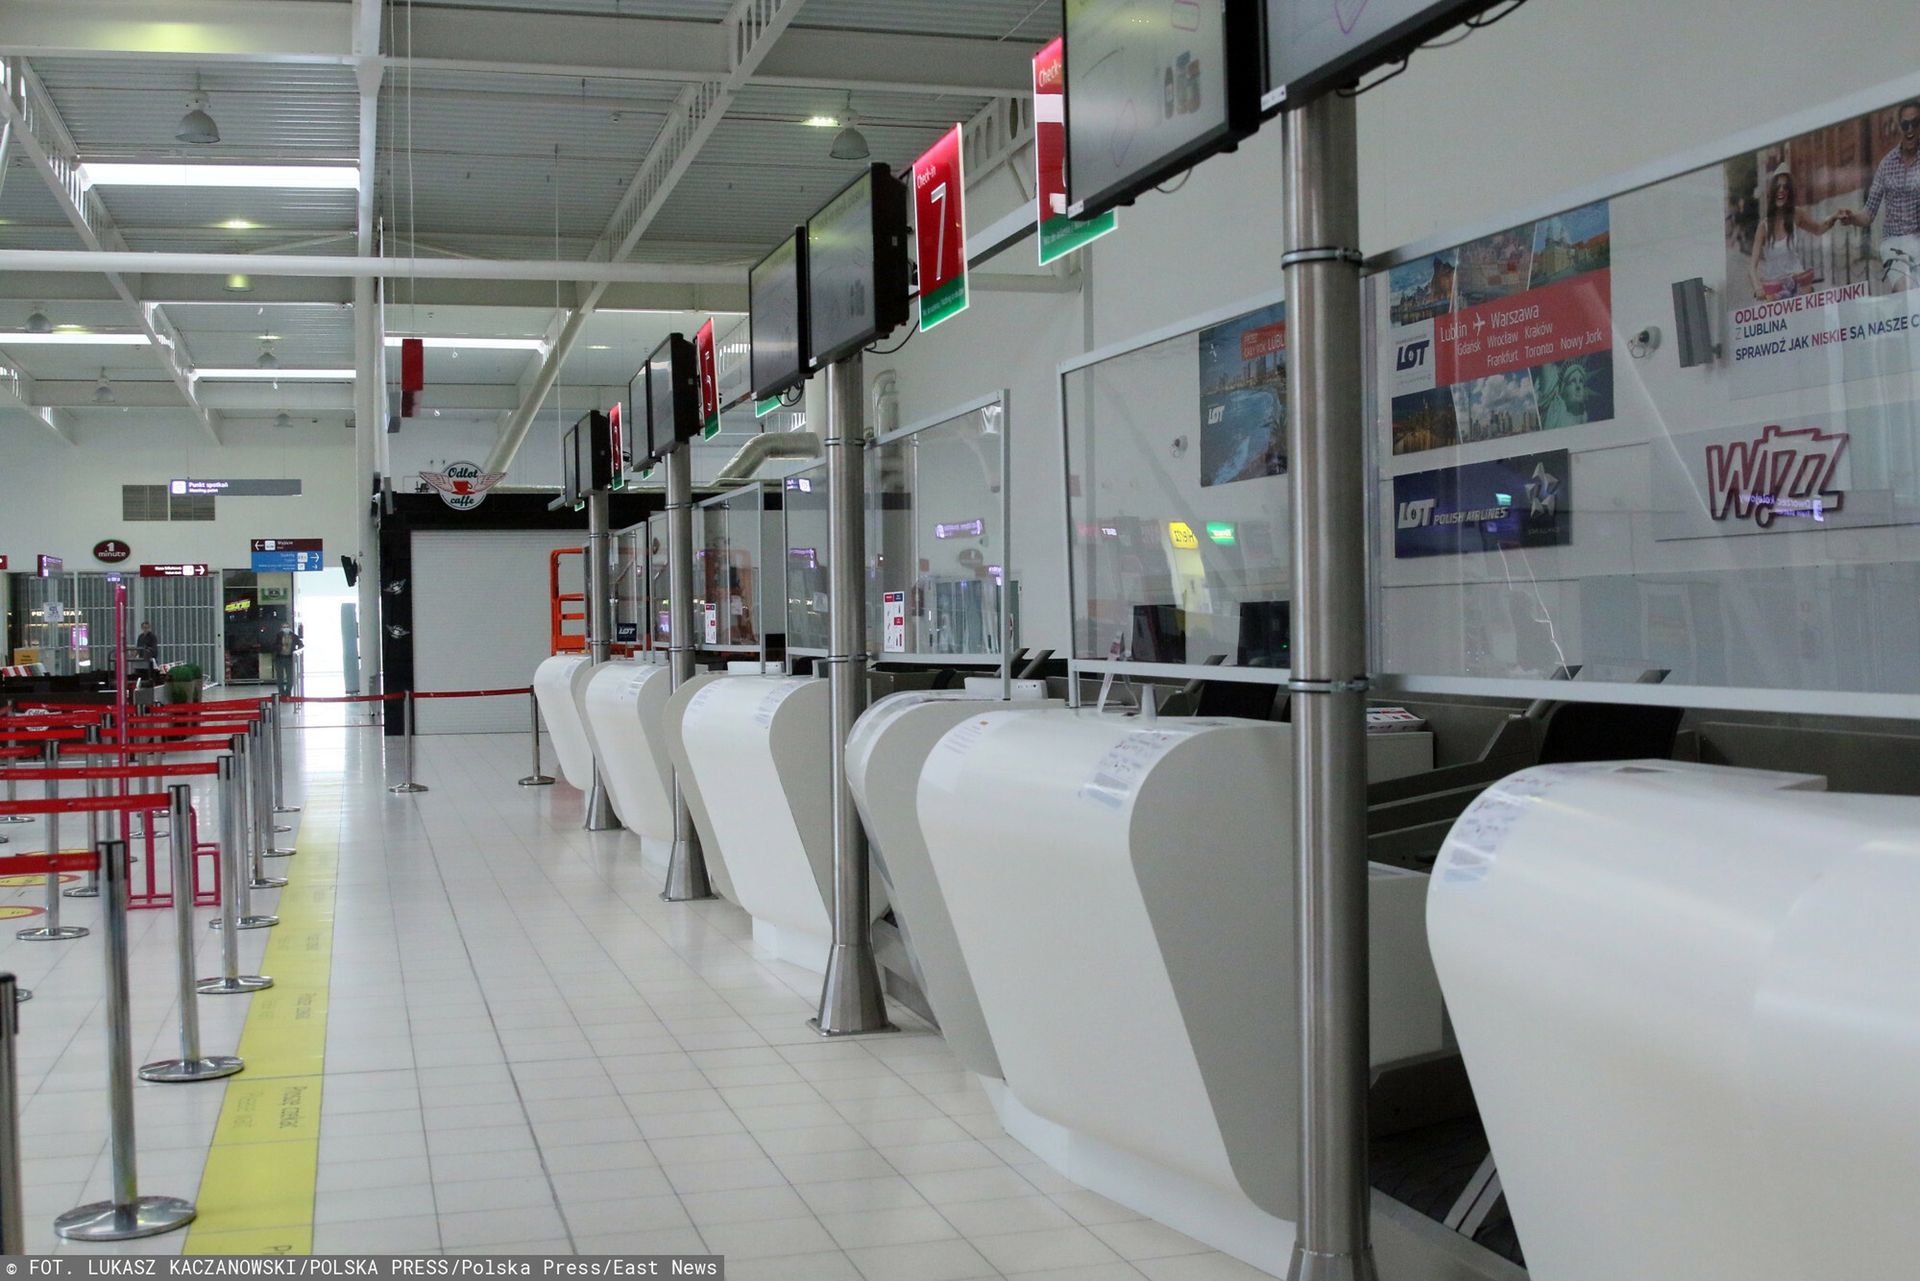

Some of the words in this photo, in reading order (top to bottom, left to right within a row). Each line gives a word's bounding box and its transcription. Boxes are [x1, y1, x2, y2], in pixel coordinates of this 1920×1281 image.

[1038, 63, 1062, 87] Check-
[917, 165, 937, 190] Check-in
[931, 182, 947, 281] 7
[1735, 298, 1802, 324] ODLOTOWE
[1805, 283, 1866, 310] KIERUNKI
[1440, 322, 1468, 343] Lublin
[1490, 304, 1540, 329] Warszawa
[1735, 337, 1786, 361] SPRAWDŹ
[1788, 335, 1809, 351] JAK
[1811, 328, 1847, 347] NISKIE
[1850, 324, 1866, 341] SĄ
[1868, 316, 1908, 335] NASZE
[1743, 318, 1788, 339] LUBLINA
[1457, 339, 1481, 357] Gdańsk
[1487, 331, 1519, 349] Wrocław
[1524, 322, 1553, 339] Kraków
[1487, 350, 1519, 368] Frankfurt
[1524, 343, 1554, 359] Toronto
[1560, 337, 1583, 351] Nowy
[1584, 328, 1602, 345] Jork
[1396, 340, 1430, 371] LOT
[1208, 406, 1225, 424] LOT
[448, 467, 478, 478] Odlot
[450, 495, 475, 506] caffe
[1398, 499, 1436, 529] LOT
[1433, 511, 1463, 526] POLISH
[1466, 507, 1507, 522] AIRLINES
[618, 627, 635, 635] LOT
